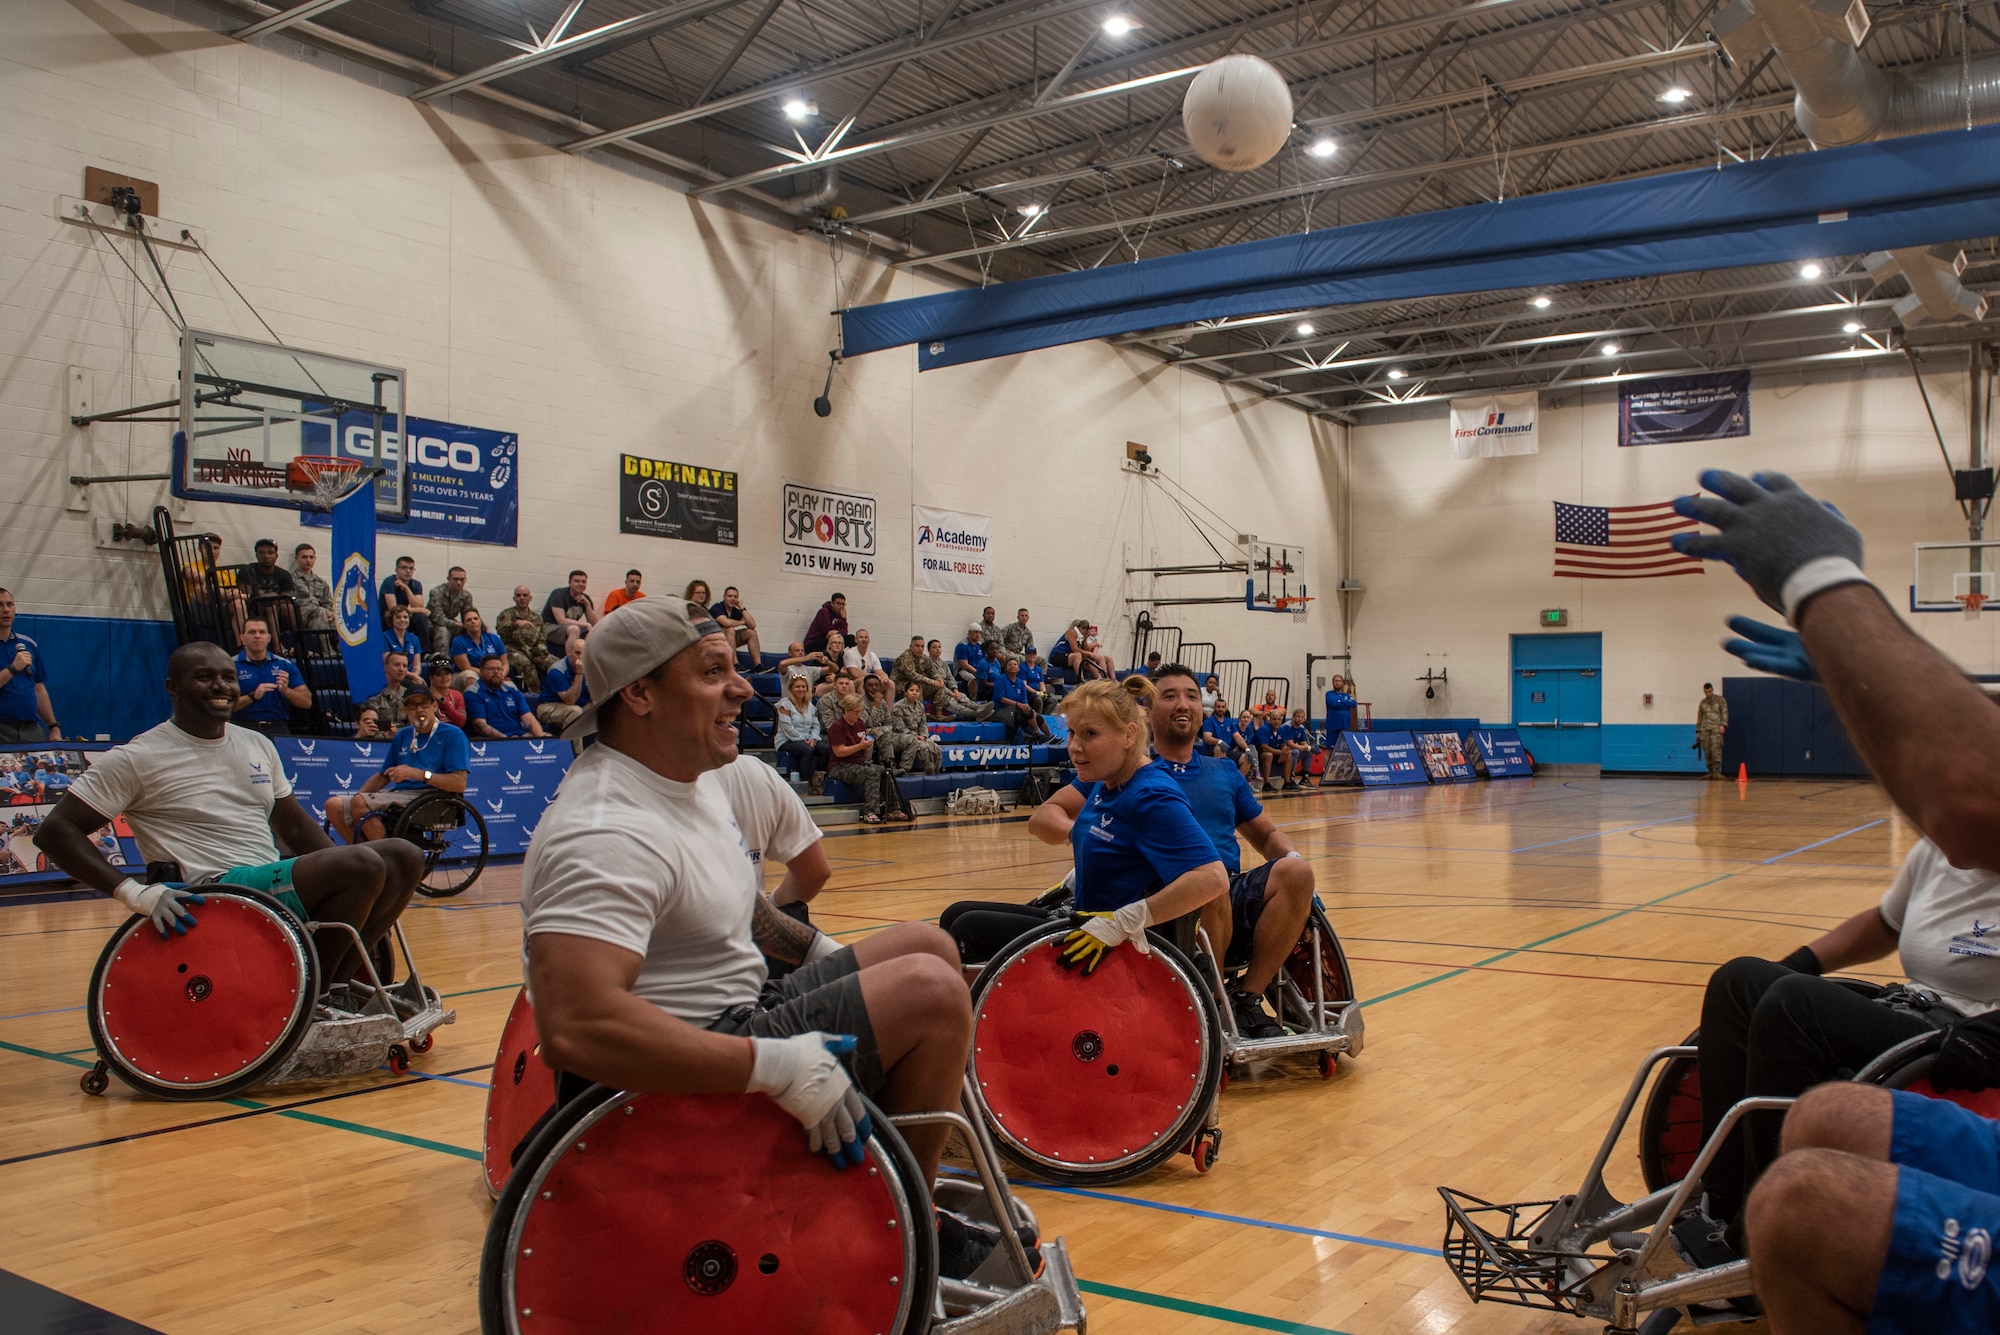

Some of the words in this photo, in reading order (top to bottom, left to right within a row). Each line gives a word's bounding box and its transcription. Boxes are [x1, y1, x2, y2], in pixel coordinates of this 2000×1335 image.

[228, 447, 251, 465] NO
[345, 425, 480, 473] GEICO
[201, 464, 280, 489] DUNKING
[419, 474, 457, 487] MILITARY
[457, 478, 464, 487] &
[624, 455, 734, 491] DOMINATE
[419, 485, 436, 495] FOR
[436, 486, 458, 498] OVER
[459, 489, 469, 499] 75
[469, 491, 495, 502] YEARS
[788, 490, 819, 511] PLAY
[823, 497, 834, 513] IT
[836, 500, 872, 520] AGAIN
[455, 514, 470, 524] Local
[471, 516, 486, 526] Office
[788, 509, 873, 549] SPORTS
[936, 527, 987, 552] Academy
[785, 552, 815, 568] 2015
[819, 555, 831, 570] W
[833, 557, 857, 576] Hwy
[861, 561, 874, 575] 50
[923, 558, 938, 570] FOR
[938, 559, 952, 572] ALL.
[953, 561, 967, 574] FOR
[968, 563, 985, 576] LESS.
[1548, 611, 1560, 621] EXIT
